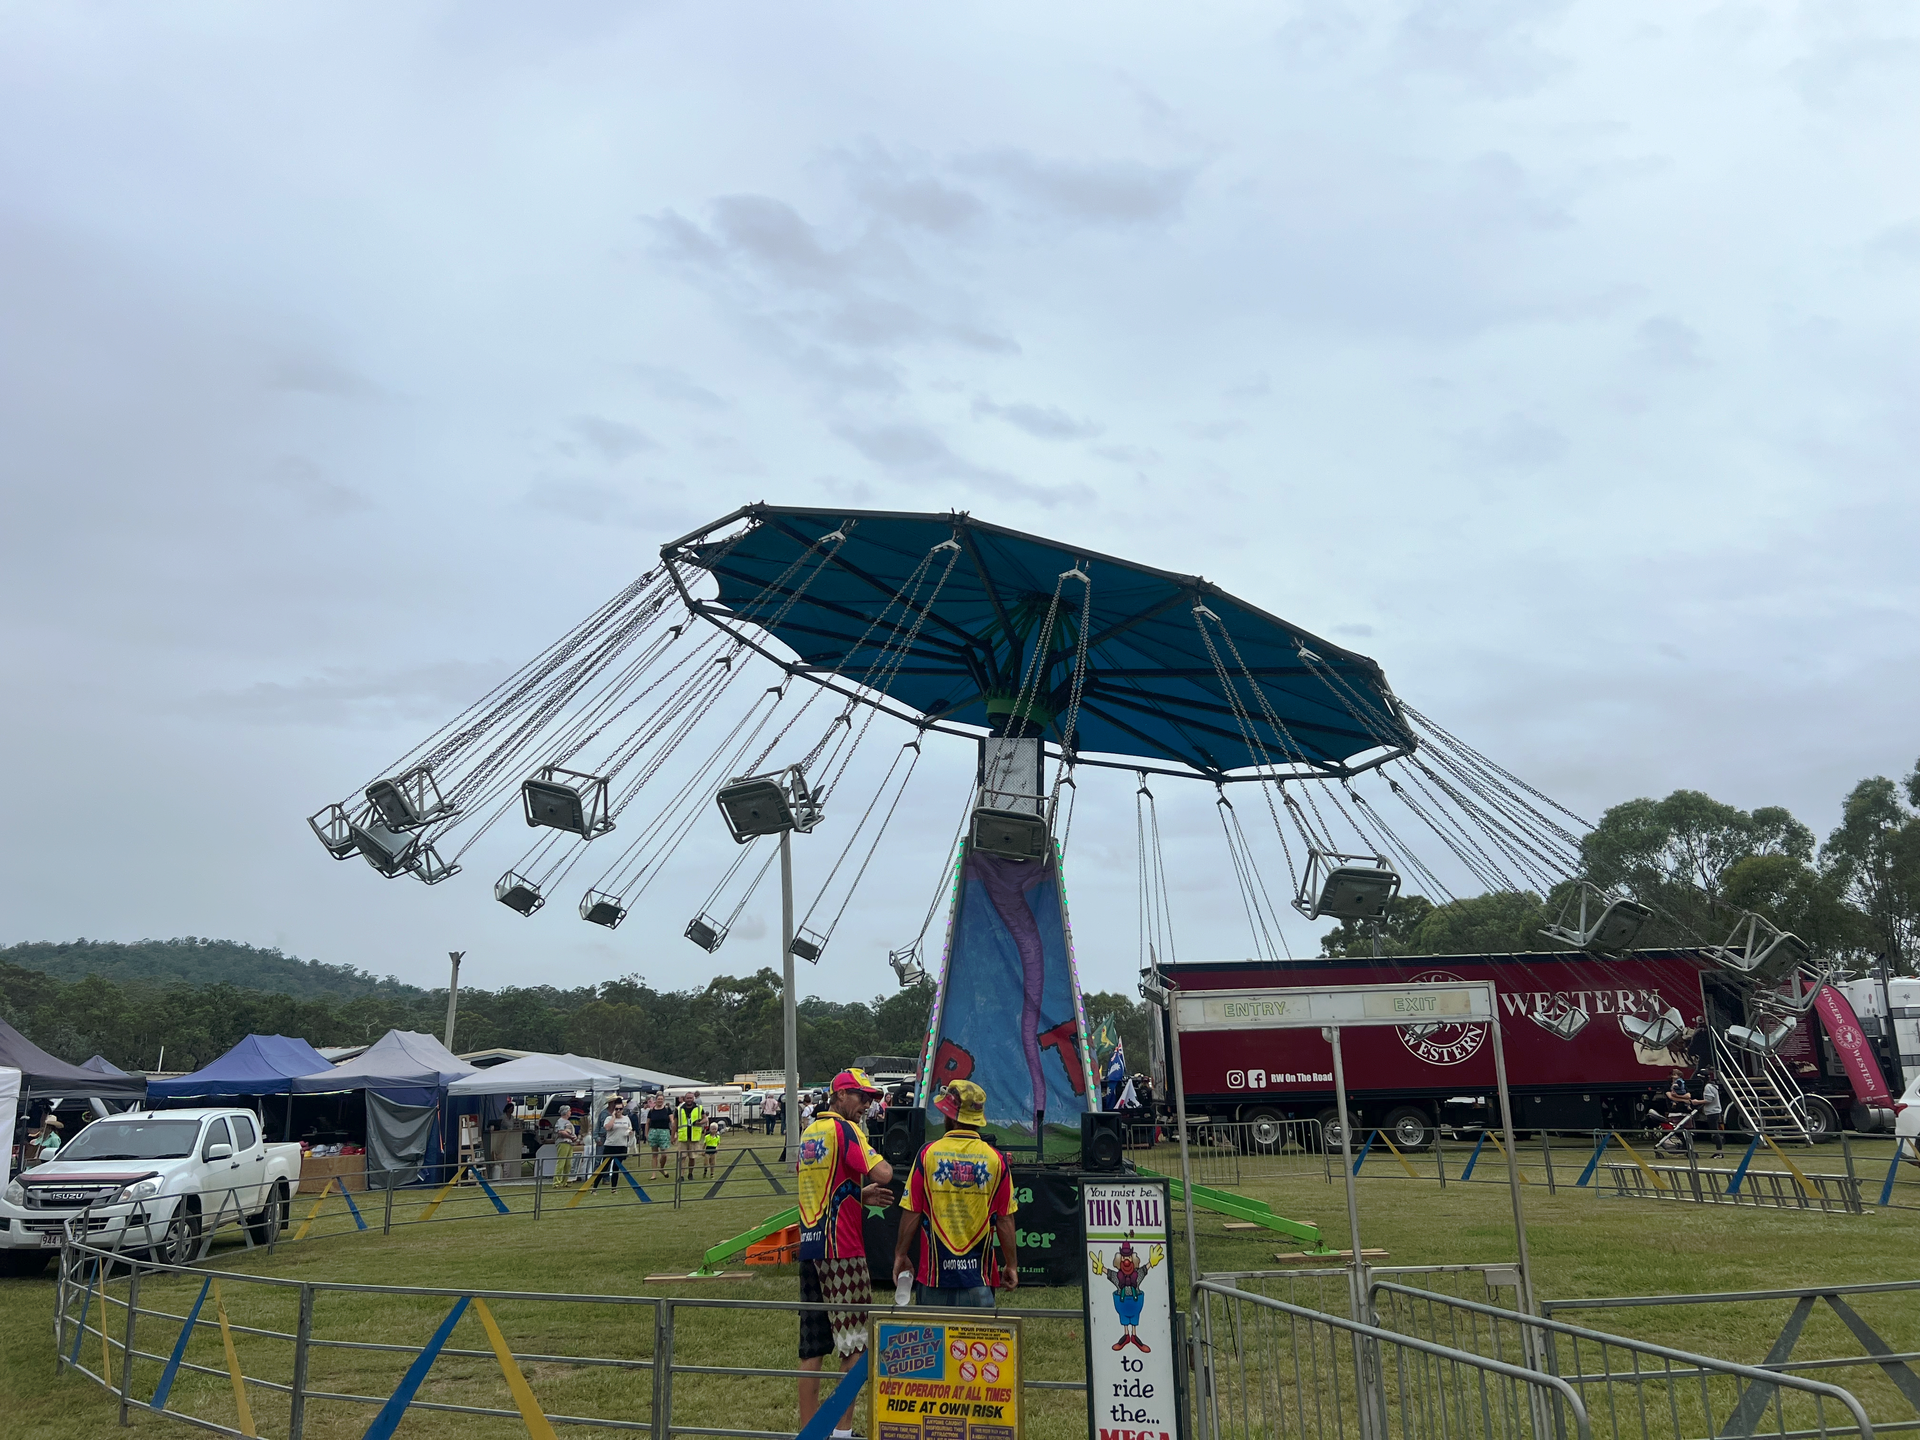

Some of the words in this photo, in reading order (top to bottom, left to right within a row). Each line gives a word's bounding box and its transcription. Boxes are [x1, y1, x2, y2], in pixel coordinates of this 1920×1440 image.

[1223, 1001, 1286, 1017] ENTRY
[1394, 997, 1436, 1011] EXIT
[1500, 989, 1660, 1017] WESTERN
[1821, 988, 1845, 1024] RINGERS
[1403, 1025, 1483, 1062] WESTERN
[1271, 1073, 1284, 1083] RW
[1285, 1073, 1296, 1082] On
[1296, 1073, 1312, 1082] The
[1312, 1072, 1333, 1082] Road
[1853, 1049, 1877, 1091] WESTERN
[1090, 1187, 1106, 1197] You
[1111, 1188, 1135, 1197] must
[1087, 1199, 1121, 1227] THIS
[1126, 1199, 1162, 1227] TALL
[967, 1258, 978, 1269] 117
[888, 1330, 918, 1345] FUN
[922, 1327, 933, 1340] &
[882, 1340, 940, 1362] SAFETY
[887, 1355, 936, 1375] GUIDE
[1121, 1355, 1143, 1372] to
[879, 1380, 904, 1396] OBEY
[904, 1382, 951, 1399] OPERATOR
[952, 1385, 965, 1400] AT
[965, 1386, 982, 1401] ALL
[984, 1387, 1012, 1403] TIMES
[1113, 1378, 1154, 1398] ride
[886, 1398, 917, 1412] RIDE
[919, 1401, 937, 1414] AT
[939, 1402, 970, 1416] OWN
[972, 1404, 1004, 1419] RISK
[1110, 1403, 1160, 1424] the...
